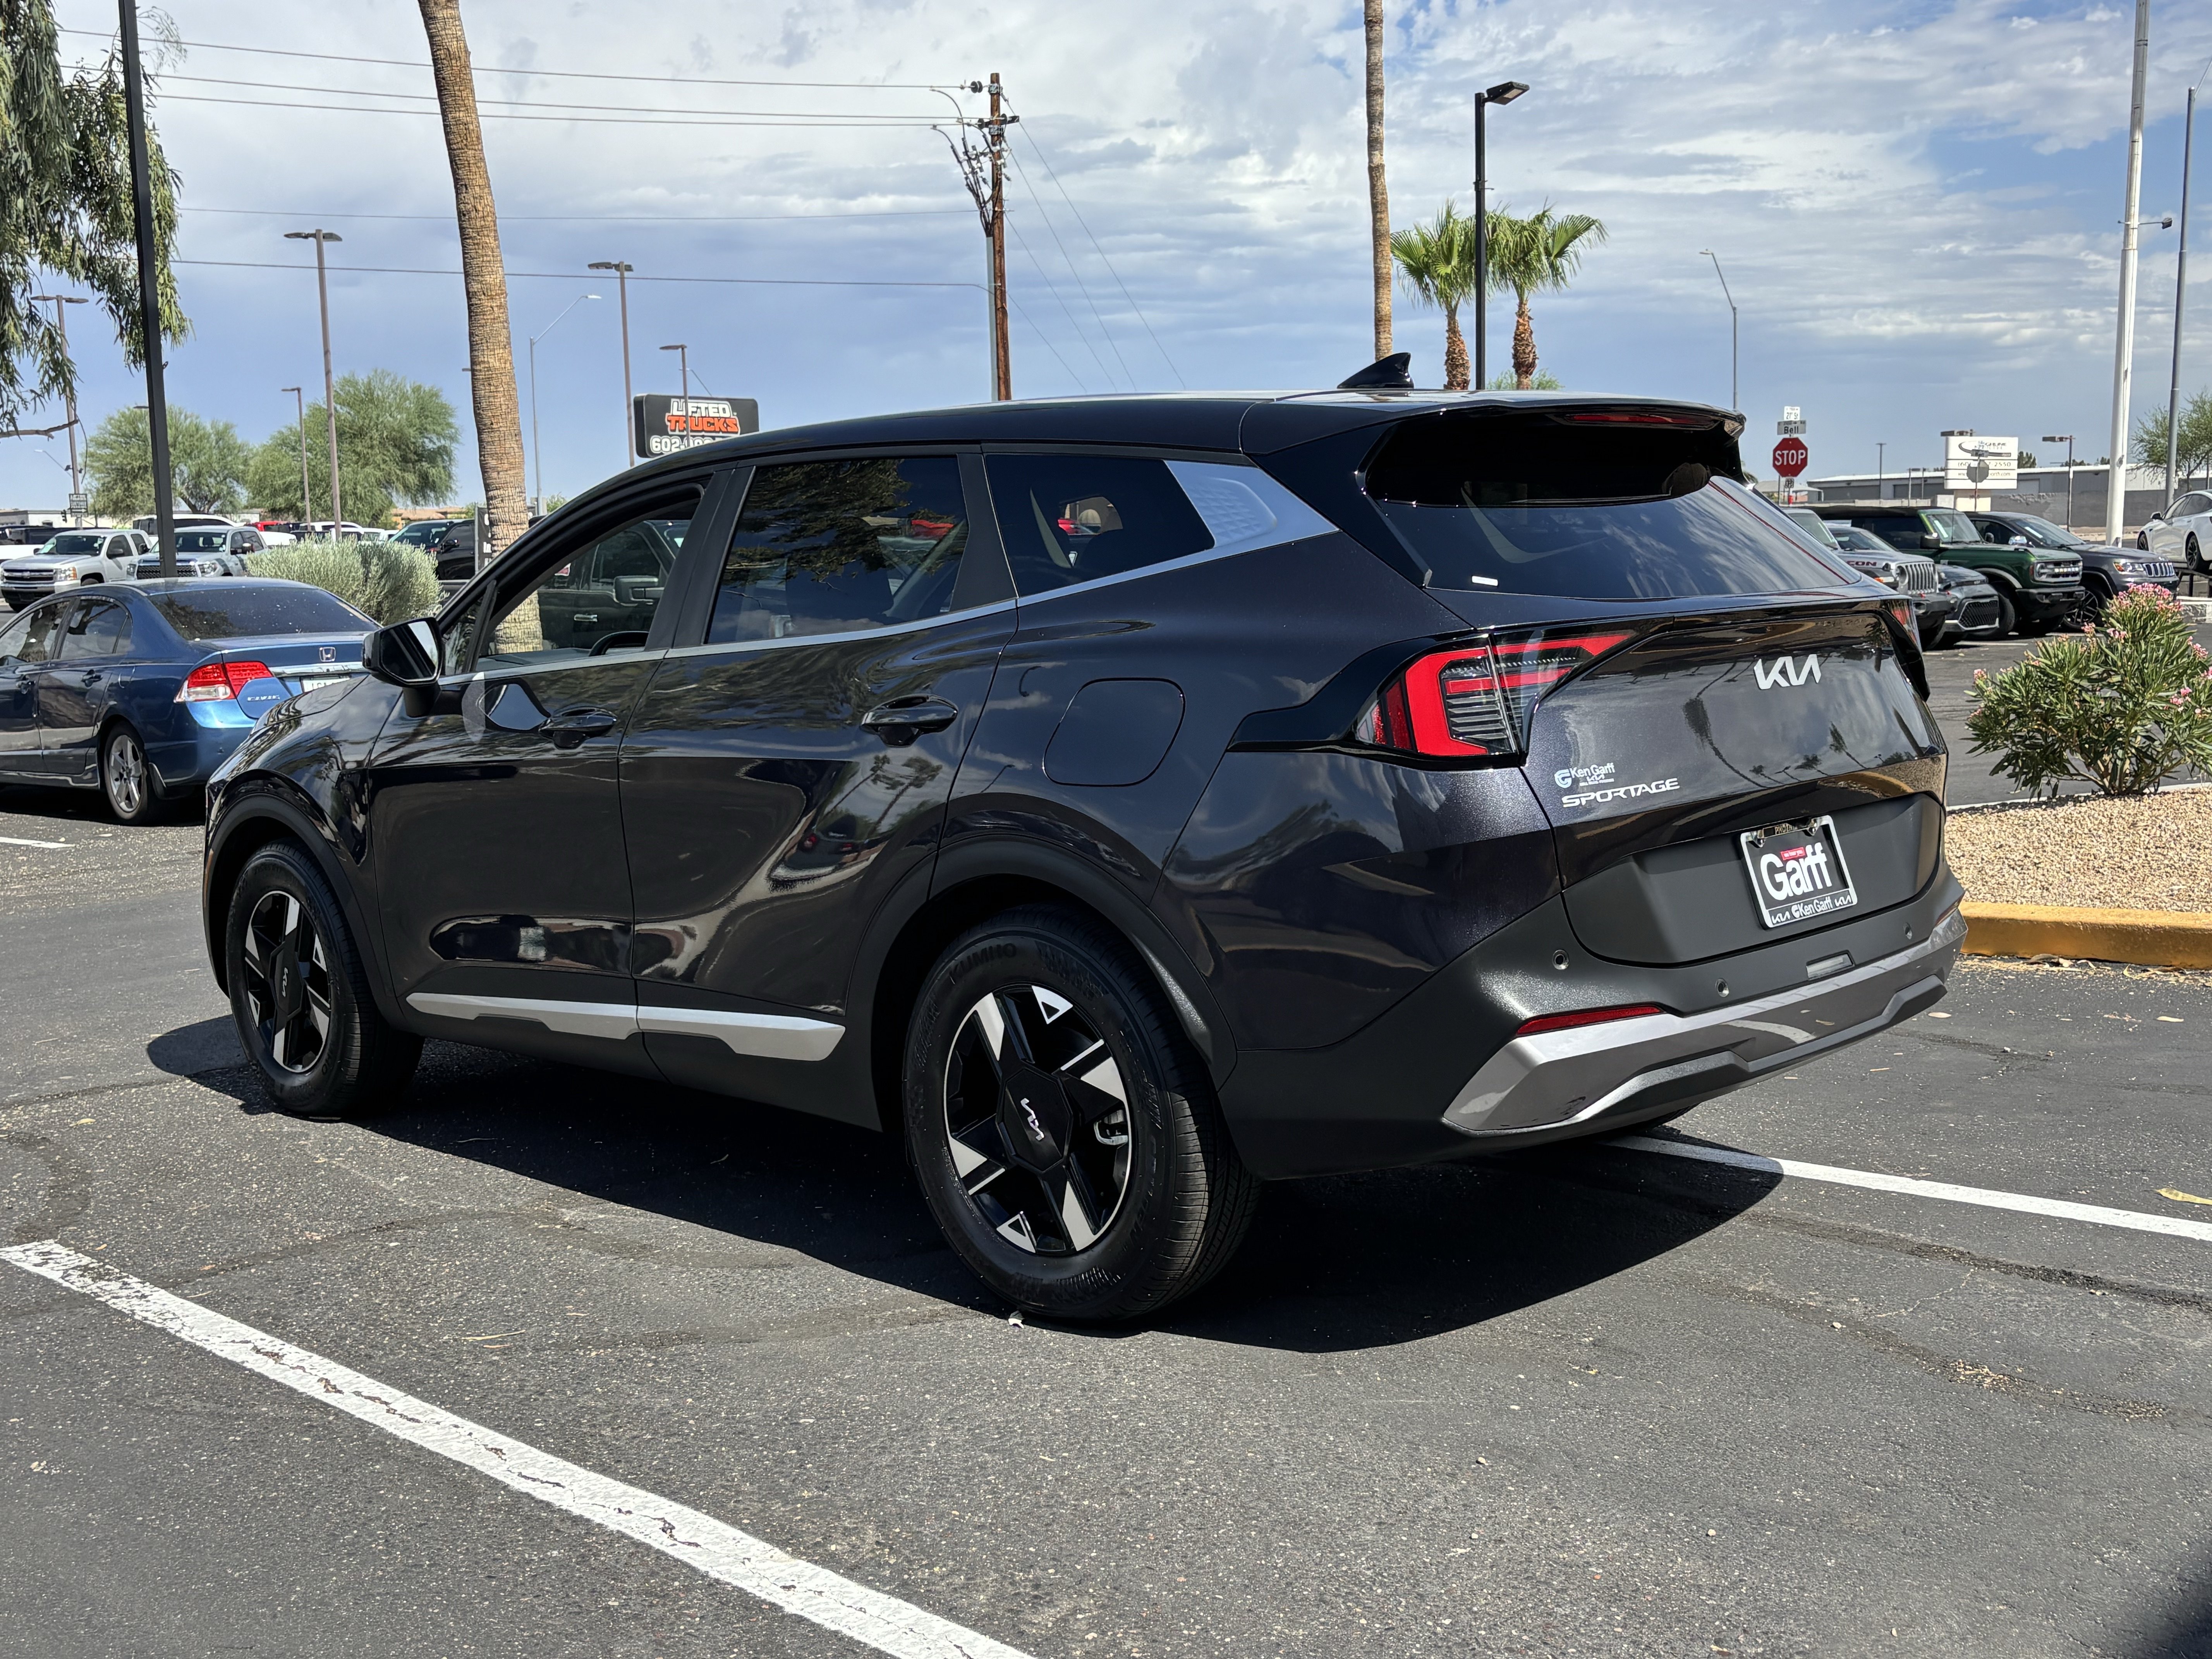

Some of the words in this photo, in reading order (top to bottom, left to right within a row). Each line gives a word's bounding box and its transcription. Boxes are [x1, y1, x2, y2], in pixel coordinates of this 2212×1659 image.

[668, 416, 738, 432] TRUCKS
[1784, 426, 1799, 434] Bell
[1775, 450, 1806, 465] STOP
[1754, 654, 1821, 690] KIA
[1561, 778, 1680, 807] SPORTAGE
[1760, 842, 1832, 900] Garff
